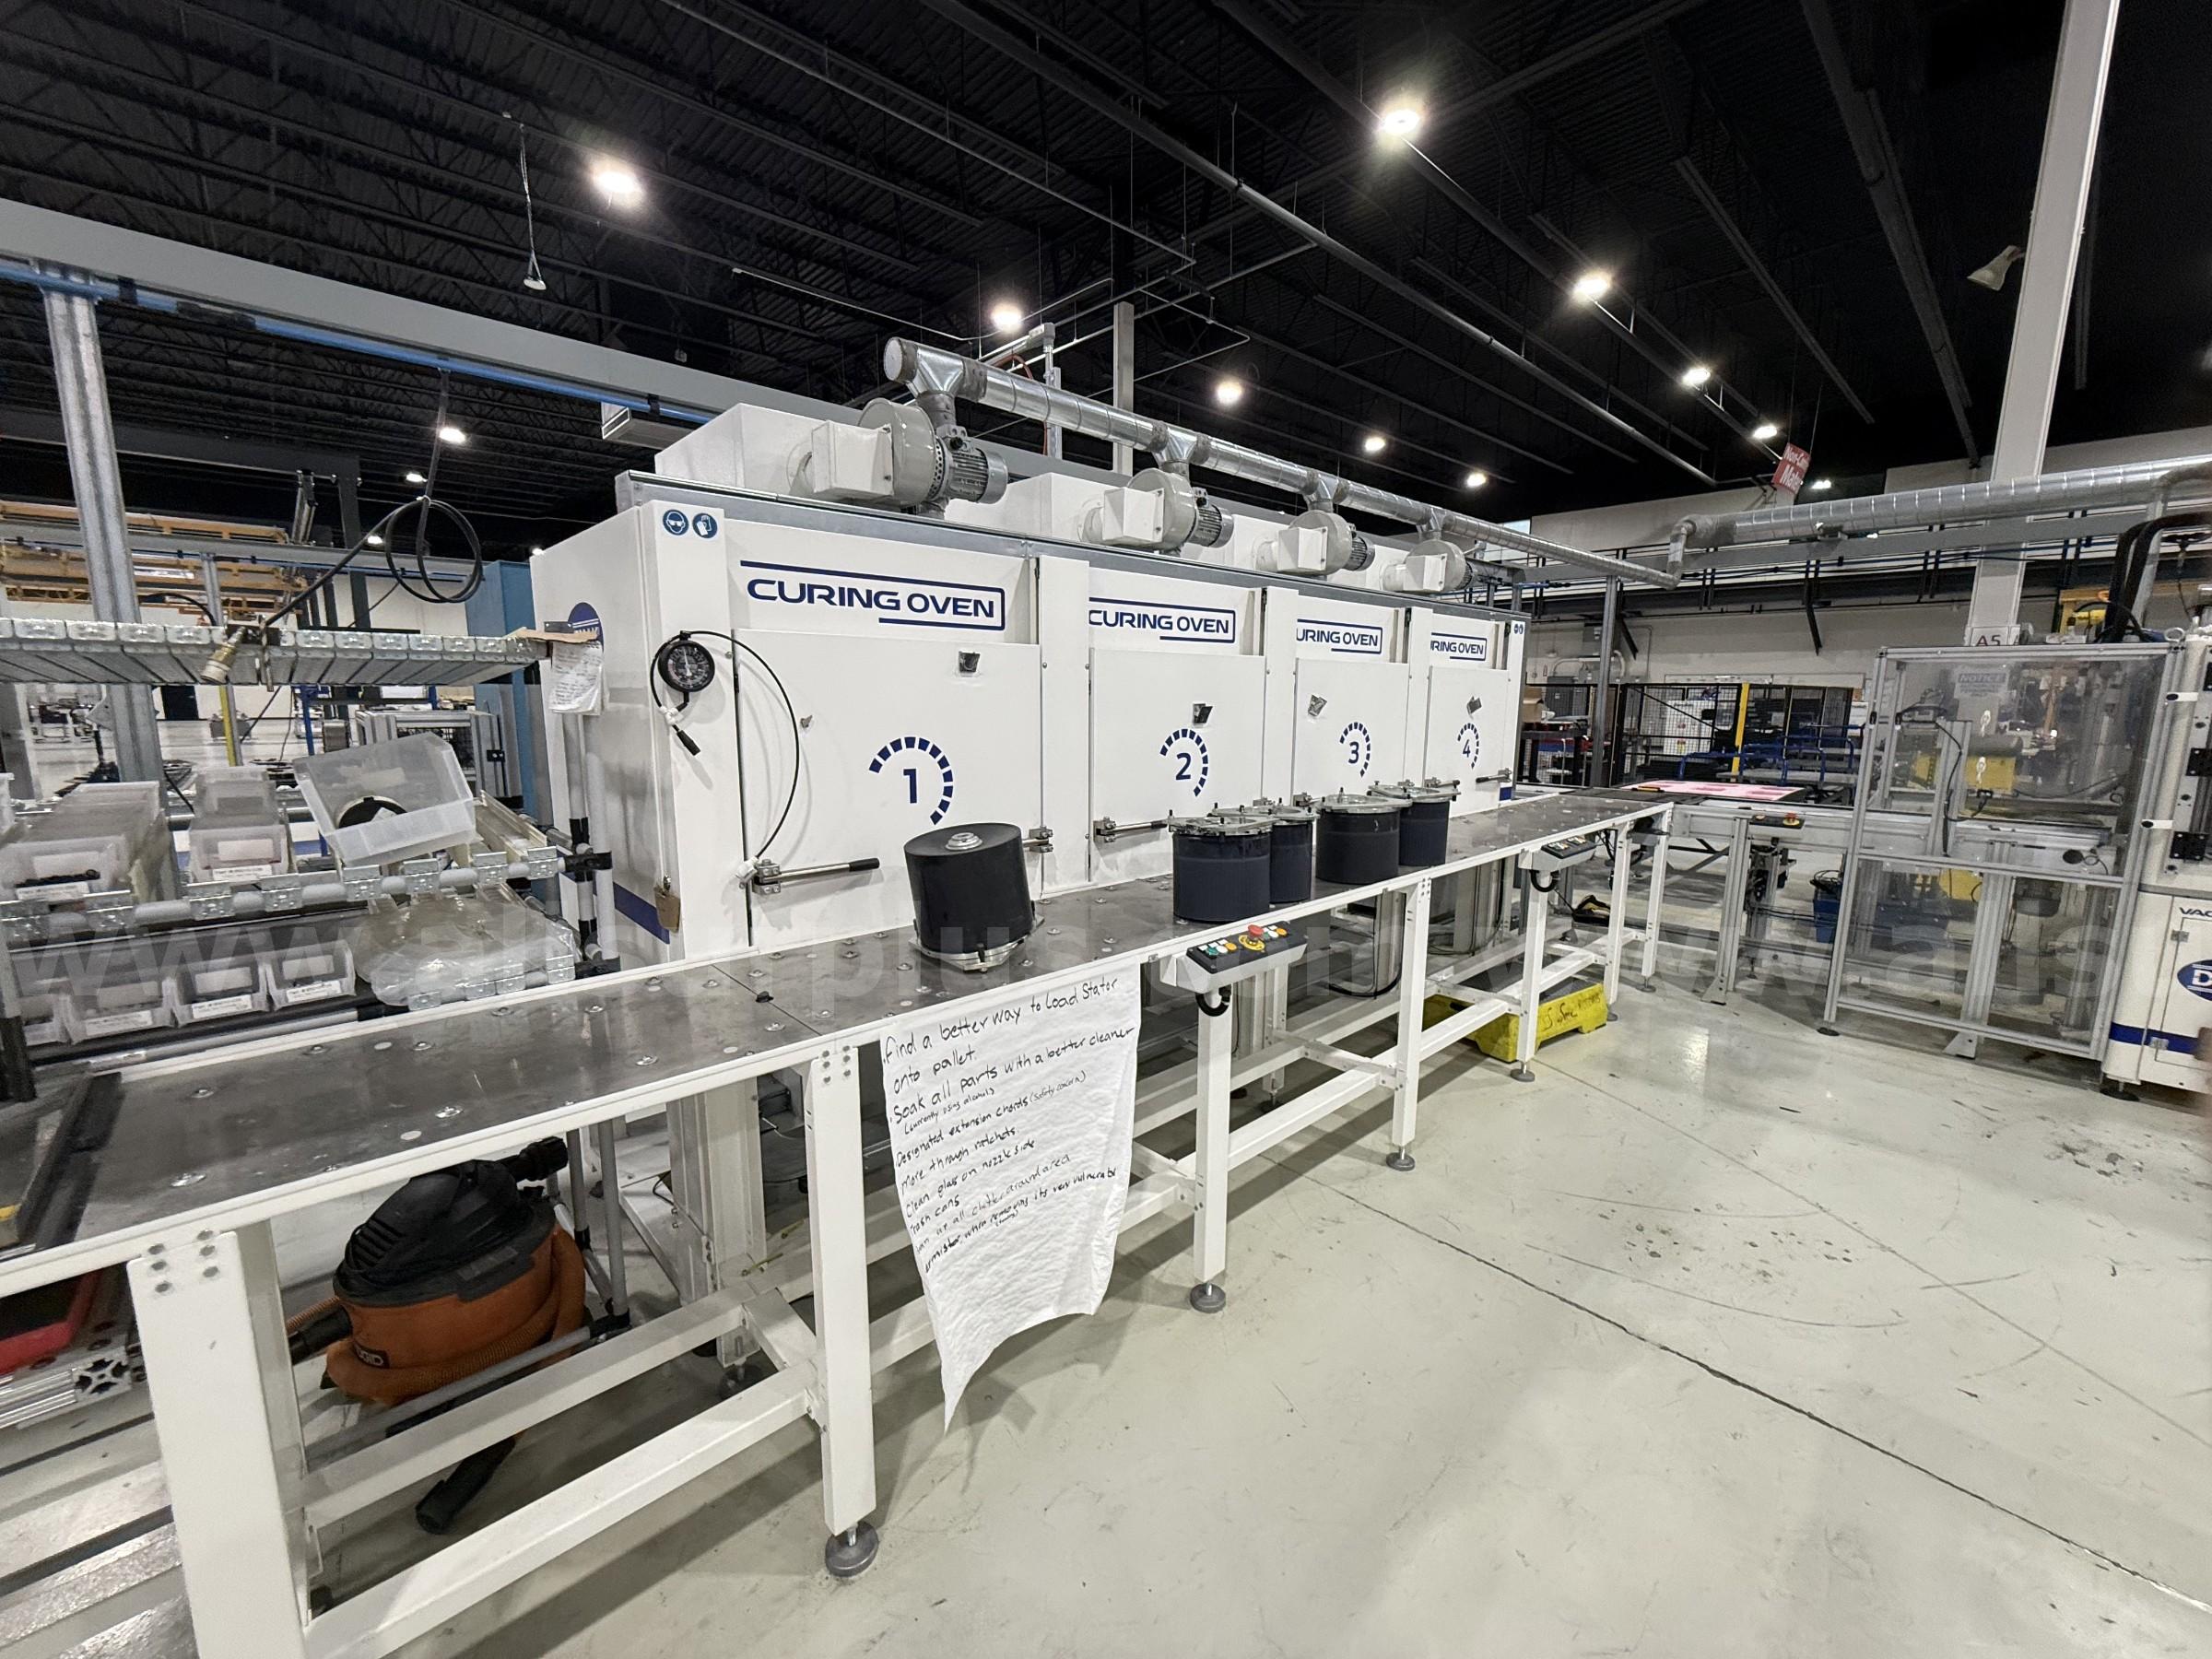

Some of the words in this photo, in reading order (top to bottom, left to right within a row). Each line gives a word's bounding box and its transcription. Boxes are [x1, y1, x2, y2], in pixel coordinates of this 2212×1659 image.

[747, 578, 901, 611] CURING
[906, 592, 995, 618] OVEN
[1088, 609, 1173, 630] CURING
[1176, 616, 1230, 634] OVEN
[1296, 628, 1341, 643] URING
[1342, 631, 1379, 647] OVEN
[1430, 640, 1457, 653] RING
[1458, 642, 1484, 655] OVEN
[1348, 741, 1359, 764] 3
[1462, 738, 1472, 759] 4
[1175, 752, 1192, 782] 2
[902, 767, 918, 805] 1
[922, 1034, 933, 1050] a
[939, 1016, 989, 1041] better
[992, 1006, 1021, 1026] way
[1030, 994, 1042, 1013] to
[893, 1092, 926, 1124] Soak
[931, 1078, 951, 1106] all
[960, 1064, 998, 1093] parts
[1003, 1053, 1032, 1075] with
[1034, 1053, 1044, 1065] a
[1045, 1037, 1086, 1059] better
[1088, 1027, 1135, 1047] cleaner
[893, 1065, 921, 1095] onto
[895, 1128, 944, 1169] Designated
[948, 1112, 992, 1136] extension
[929, 1146, 970, 1171] through
[906, 1193, 930, 1218] Clean
[961, 1168, 978, 1182] on
[953, 1209, 965, 1225] all
[1006, 1164, 1041, 1194] around
[1042, 1153, 1071, 1173] area
[1053, 1180, 1071, 1194] very
[935, 1194, 960, 1218] cans
